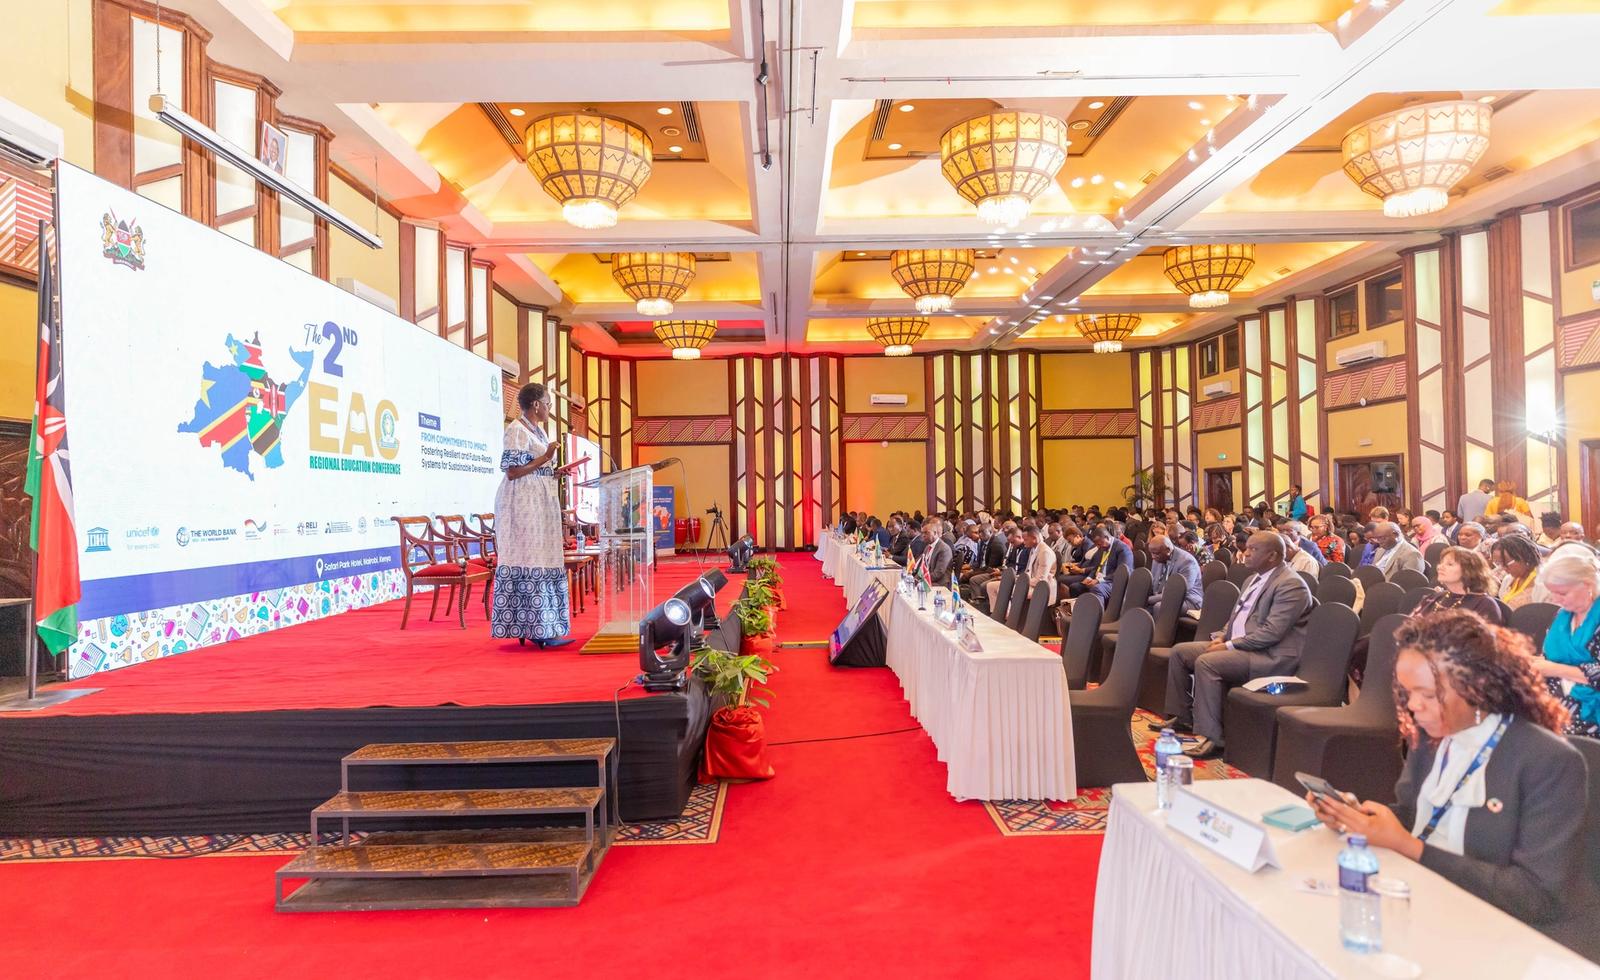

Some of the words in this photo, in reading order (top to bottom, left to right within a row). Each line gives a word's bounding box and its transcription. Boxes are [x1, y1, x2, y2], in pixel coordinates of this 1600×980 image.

[304, 323, 323, 346] The
[308, 380, 400, 460] EAC
[420, 415, 438, 427] Theme
[421, 432, 436, 443] FROM
[436, 434, 467, 449] COMMITMENTS
[467, 440, 474, 450] TO
[421, 445, 443, 459] Fostering
[443, 448, 461, 460] Resilient
[309, 455, 340, 471] REGIONAL
[341, 458, 371, 473] EDUCATION
[372, 461, 401, 475] CONFERENCE
[421, 458, 441, 470] Systems
[448, 461, 471, 473] Sustainable
[471, 464, 494, 474] Development
[126, 527, 150, 538] unicef
[191, 529, 202, 537] THE
[202, 529, 222, 537] WORLD
[223, 528, 238, 536] BANK
[306, 521, 318, 530] RELI
[324, 561, 338, 571] Safari
[339, 560, 350, 569] Park
[379, 555, 392, 564] Kenya
